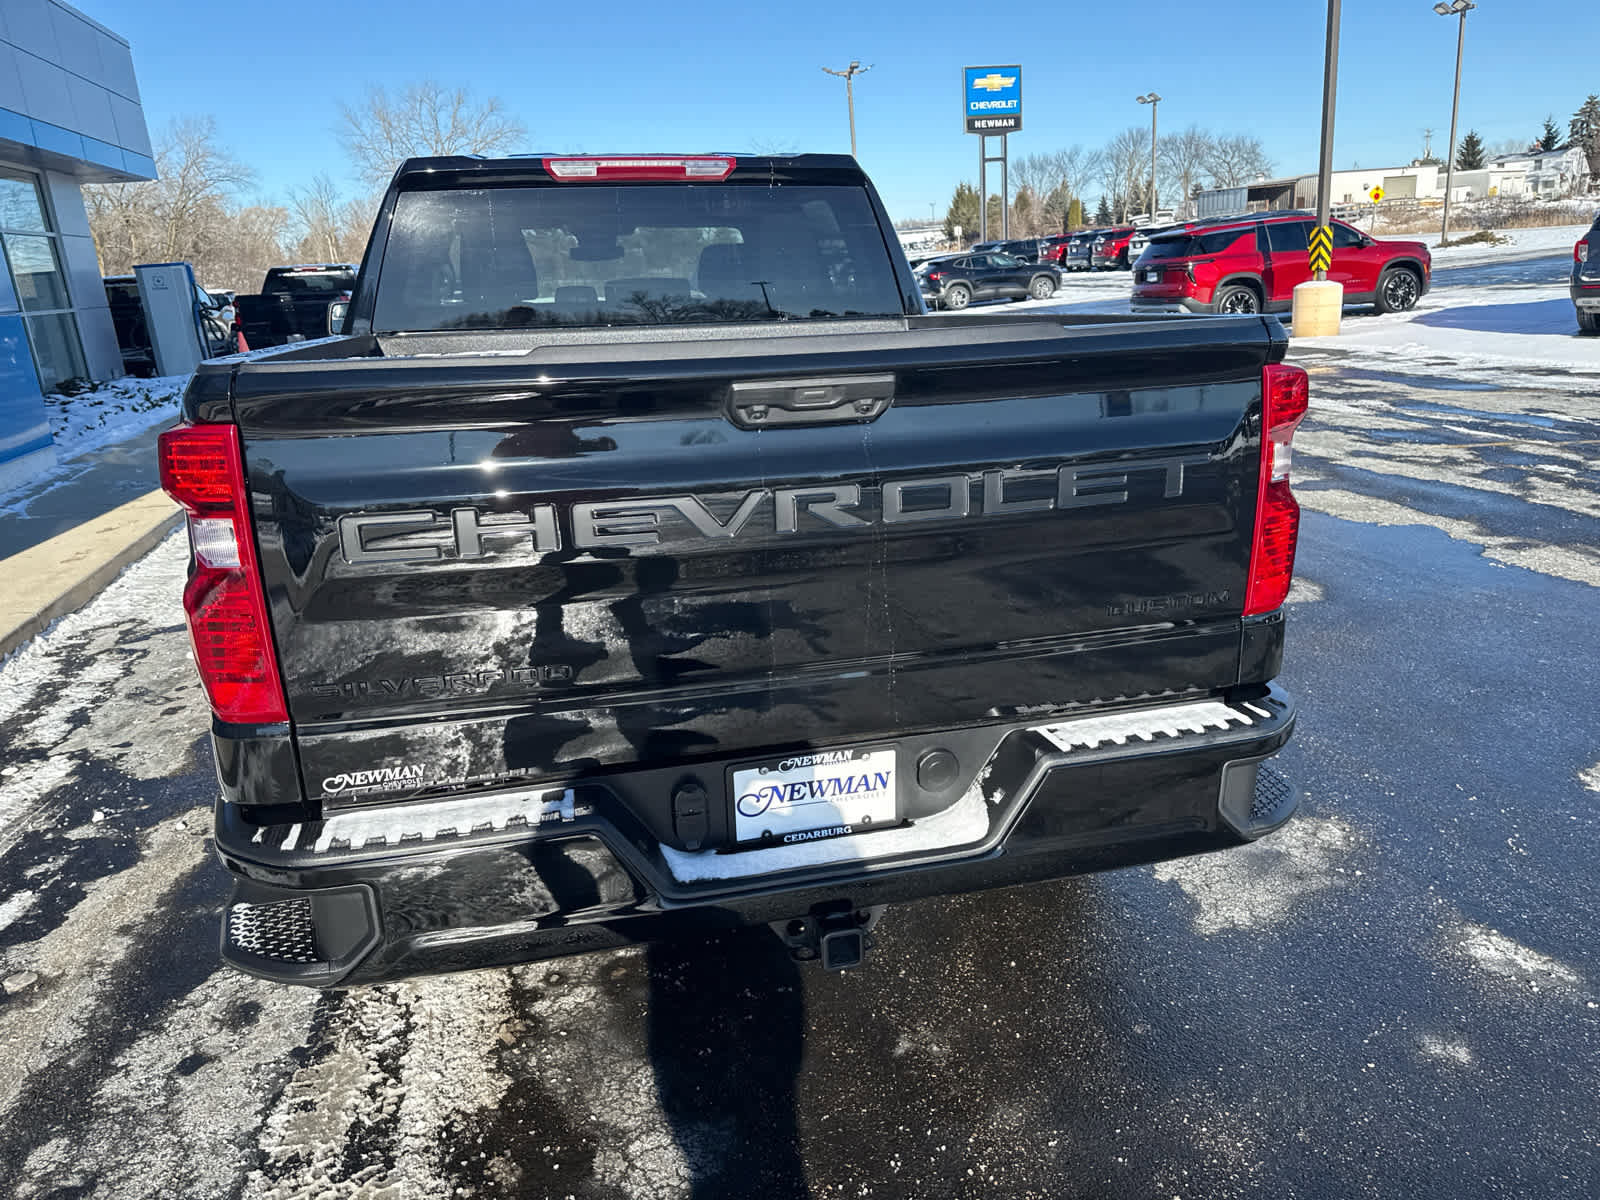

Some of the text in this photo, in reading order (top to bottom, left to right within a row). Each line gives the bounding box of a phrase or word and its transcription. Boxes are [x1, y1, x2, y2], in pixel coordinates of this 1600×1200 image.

[970, 99, 1018, 110] CHEVROLET
[974, 118, 1015, 129] NEWMAN
[336, 453, 1212, 565] CHEVROLET
[308, 664, 575, 698] SILVERADO
[778, 749, 854, 773] NEWMAN
[322, 763, 426, 793] NEWMAN
[736, 771, 892, 818] NEWMAN
[783, 825, 852, 843] CEDARBURG
